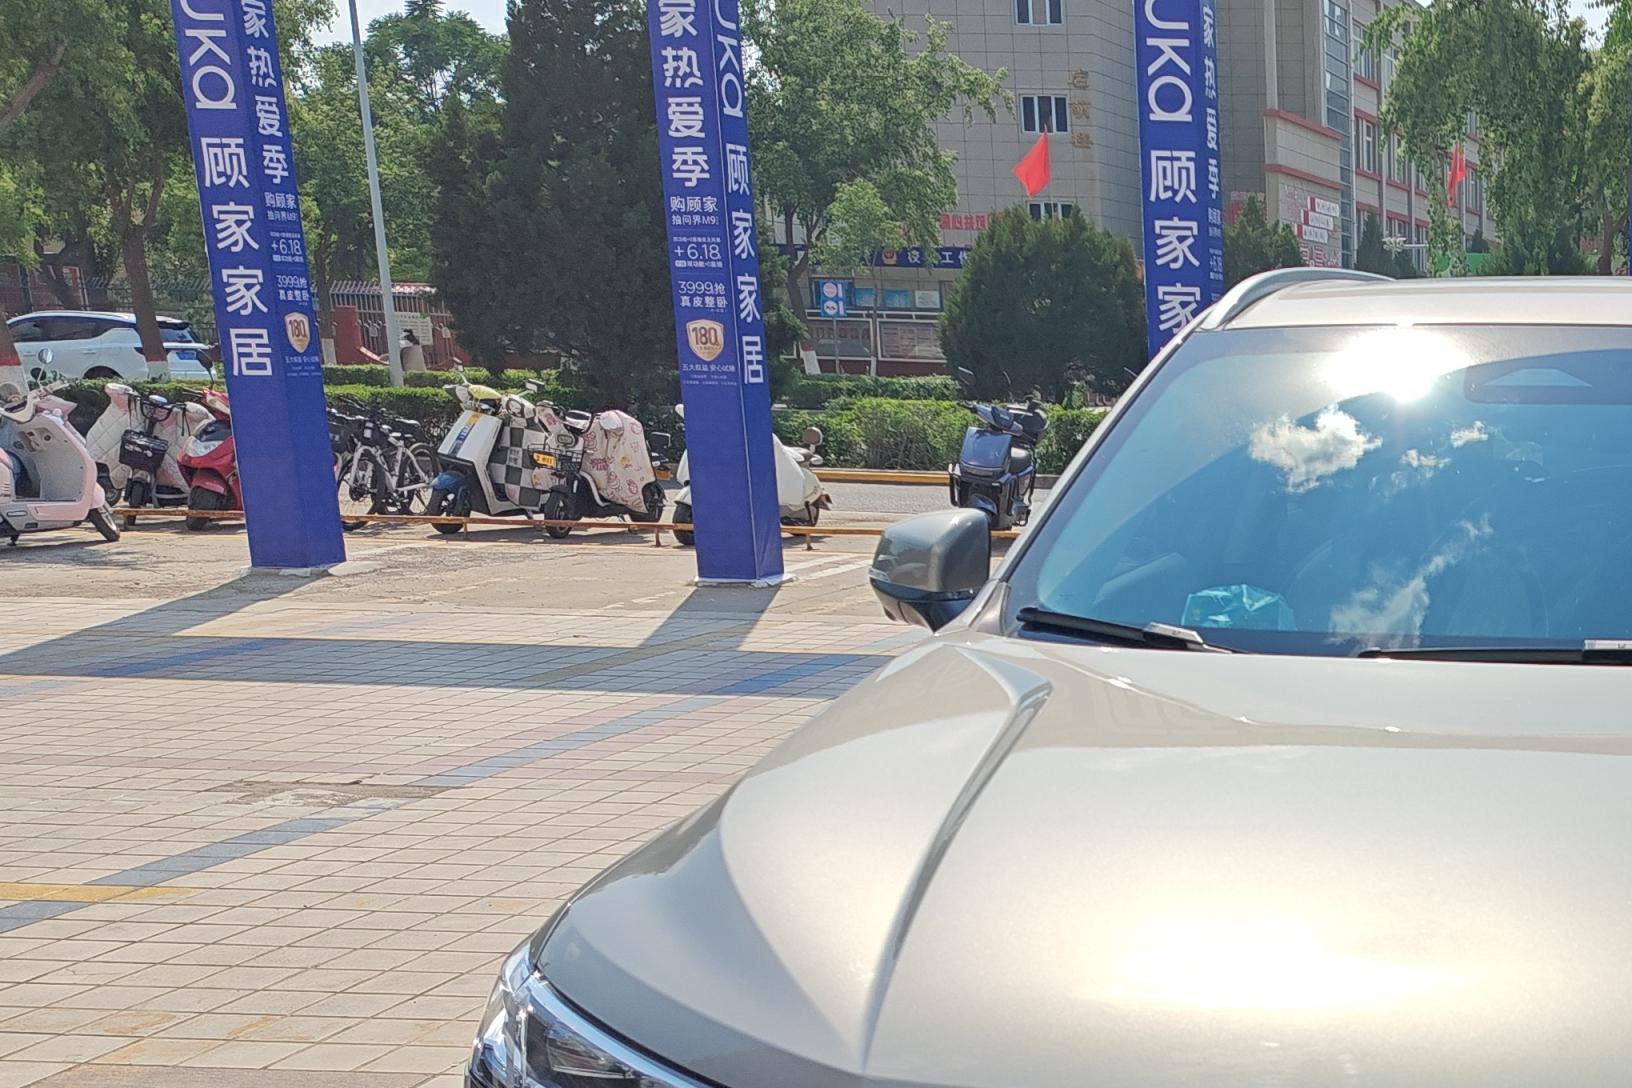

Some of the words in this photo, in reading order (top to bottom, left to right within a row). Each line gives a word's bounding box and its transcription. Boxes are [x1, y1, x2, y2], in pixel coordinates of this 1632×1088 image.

[241, 0, 289, 184] 家热爱季
[658, 0, 710, 187] 家热爱季
[201, 137, 272, 376] 顾家家居
[670, 196, 718, 213] 购顾家
[726, 143, 764, 384] 顾家家居
[1149, 150, 1200, 350] 顾家家
[680, 295, 728, 308] 真皮整卧
